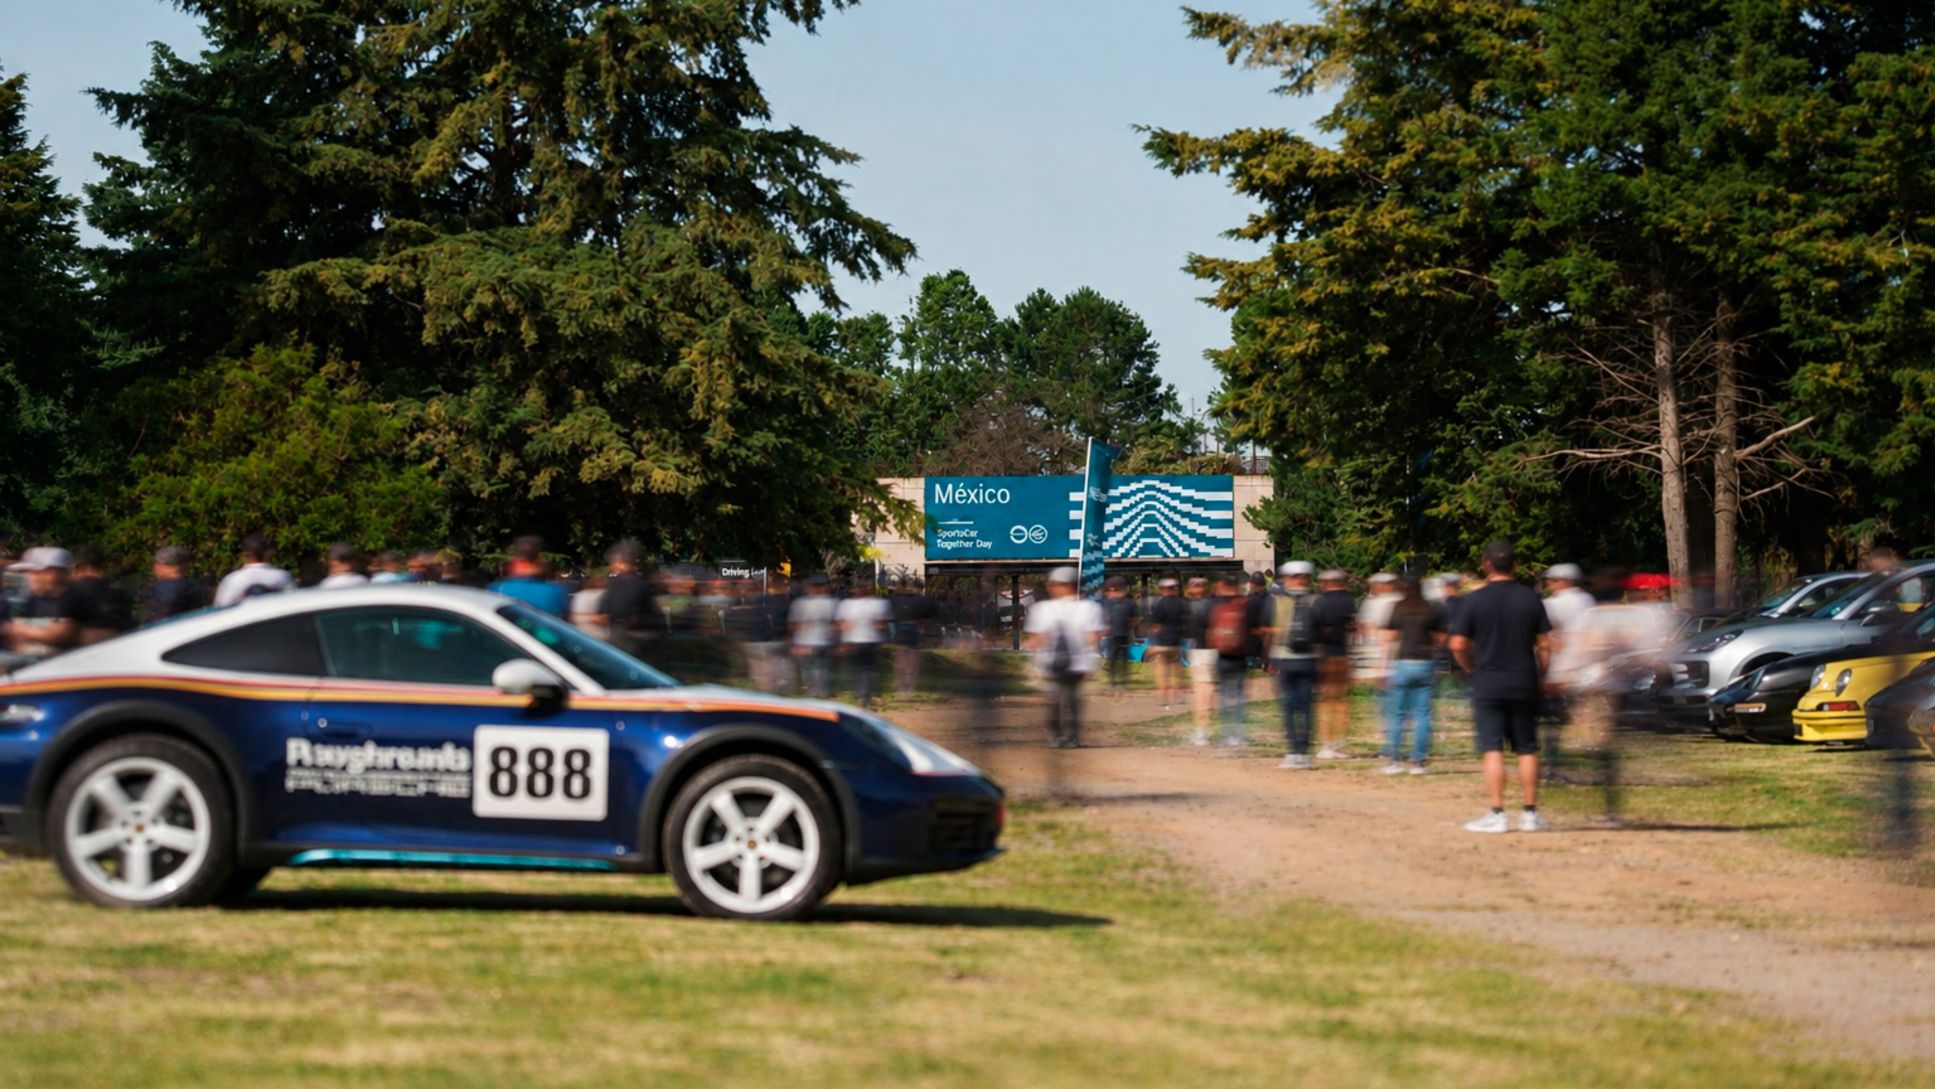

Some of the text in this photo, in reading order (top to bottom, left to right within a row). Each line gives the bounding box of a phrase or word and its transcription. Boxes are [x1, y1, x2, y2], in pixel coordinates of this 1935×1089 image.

[934, 482, 1010, 504] México
[937, 539, 992, 550] Together Day
[721, 567, 750, 579] Driving
[489, 746, 592, 800] 888
